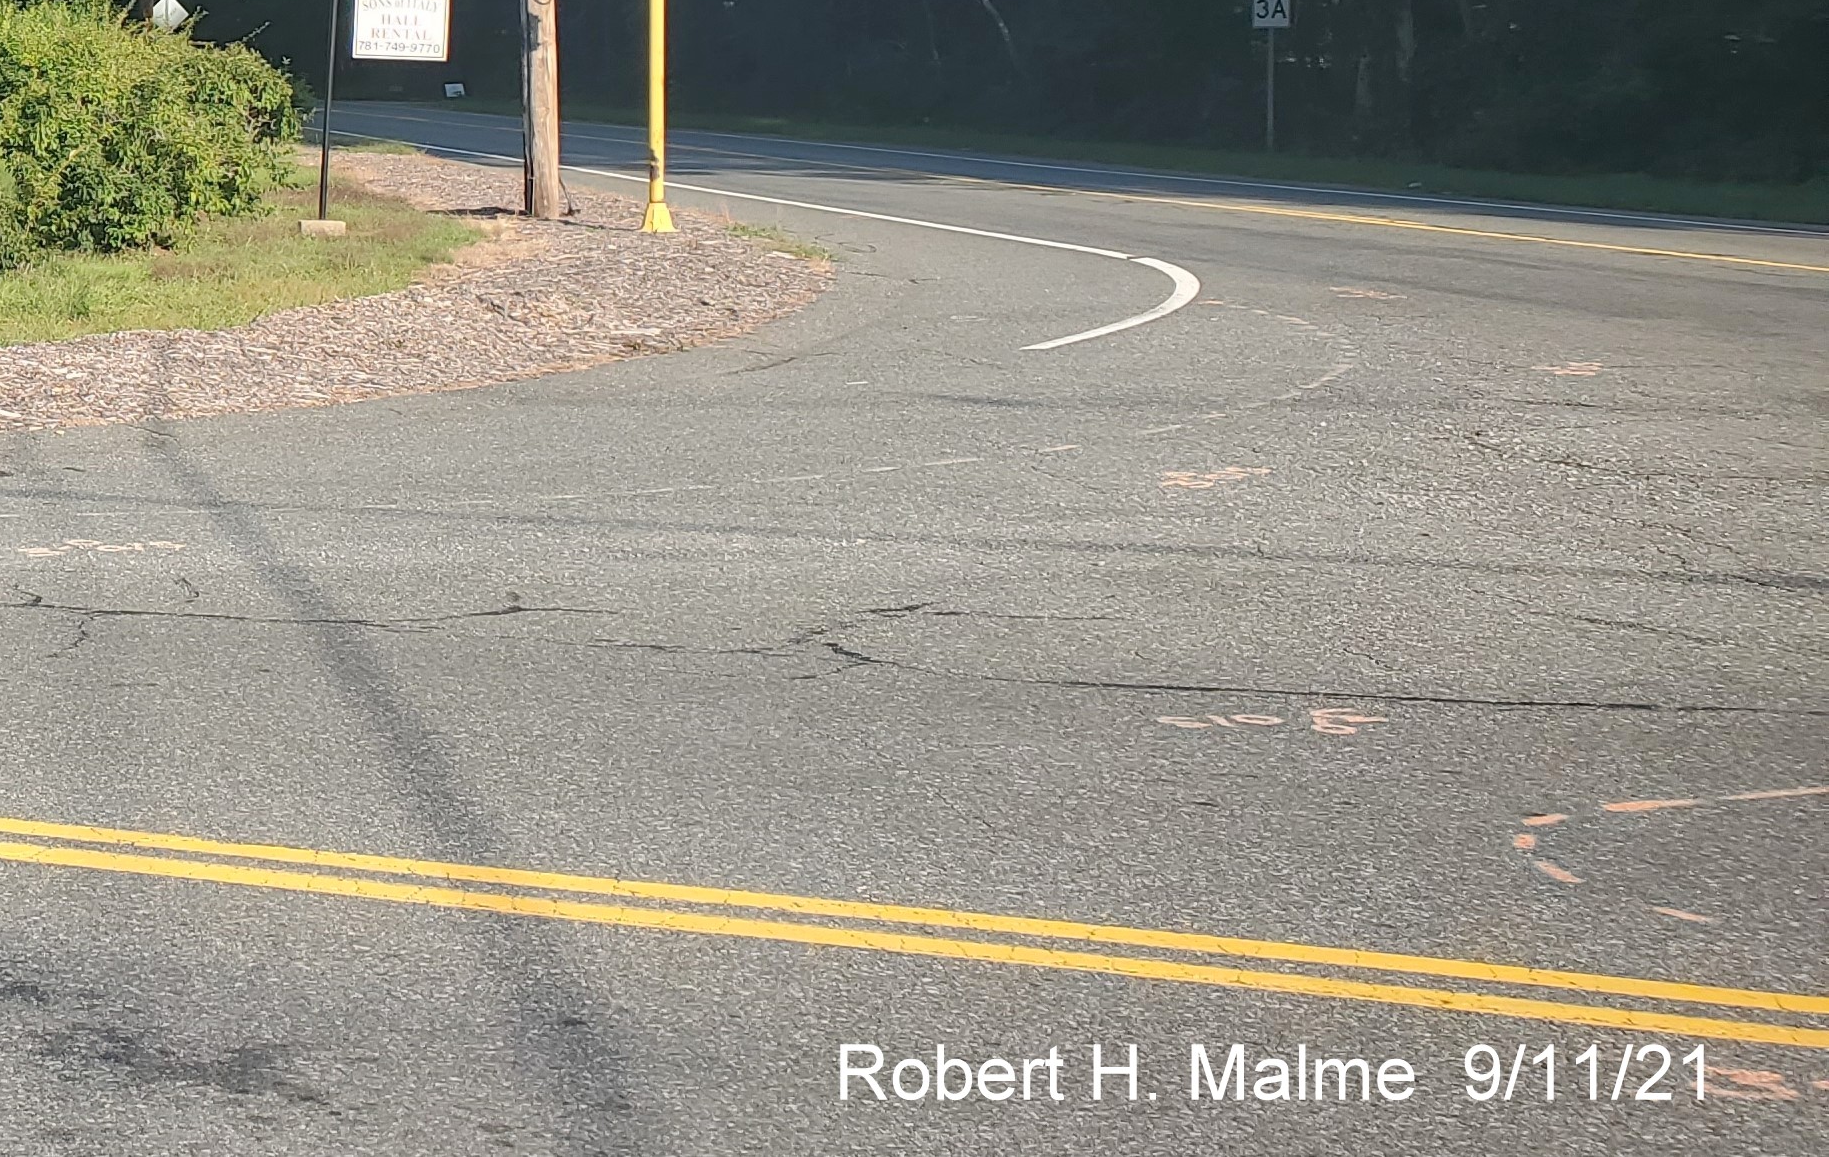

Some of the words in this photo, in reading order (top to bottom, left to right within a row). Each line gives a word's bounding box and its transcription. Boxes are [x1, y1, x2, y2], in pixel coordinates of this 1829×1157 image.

[381, 14, 421, 26] HALL
[371, 28, 432, 40] RENTAL
[358, 41, 440, 53] 781-749-9770
